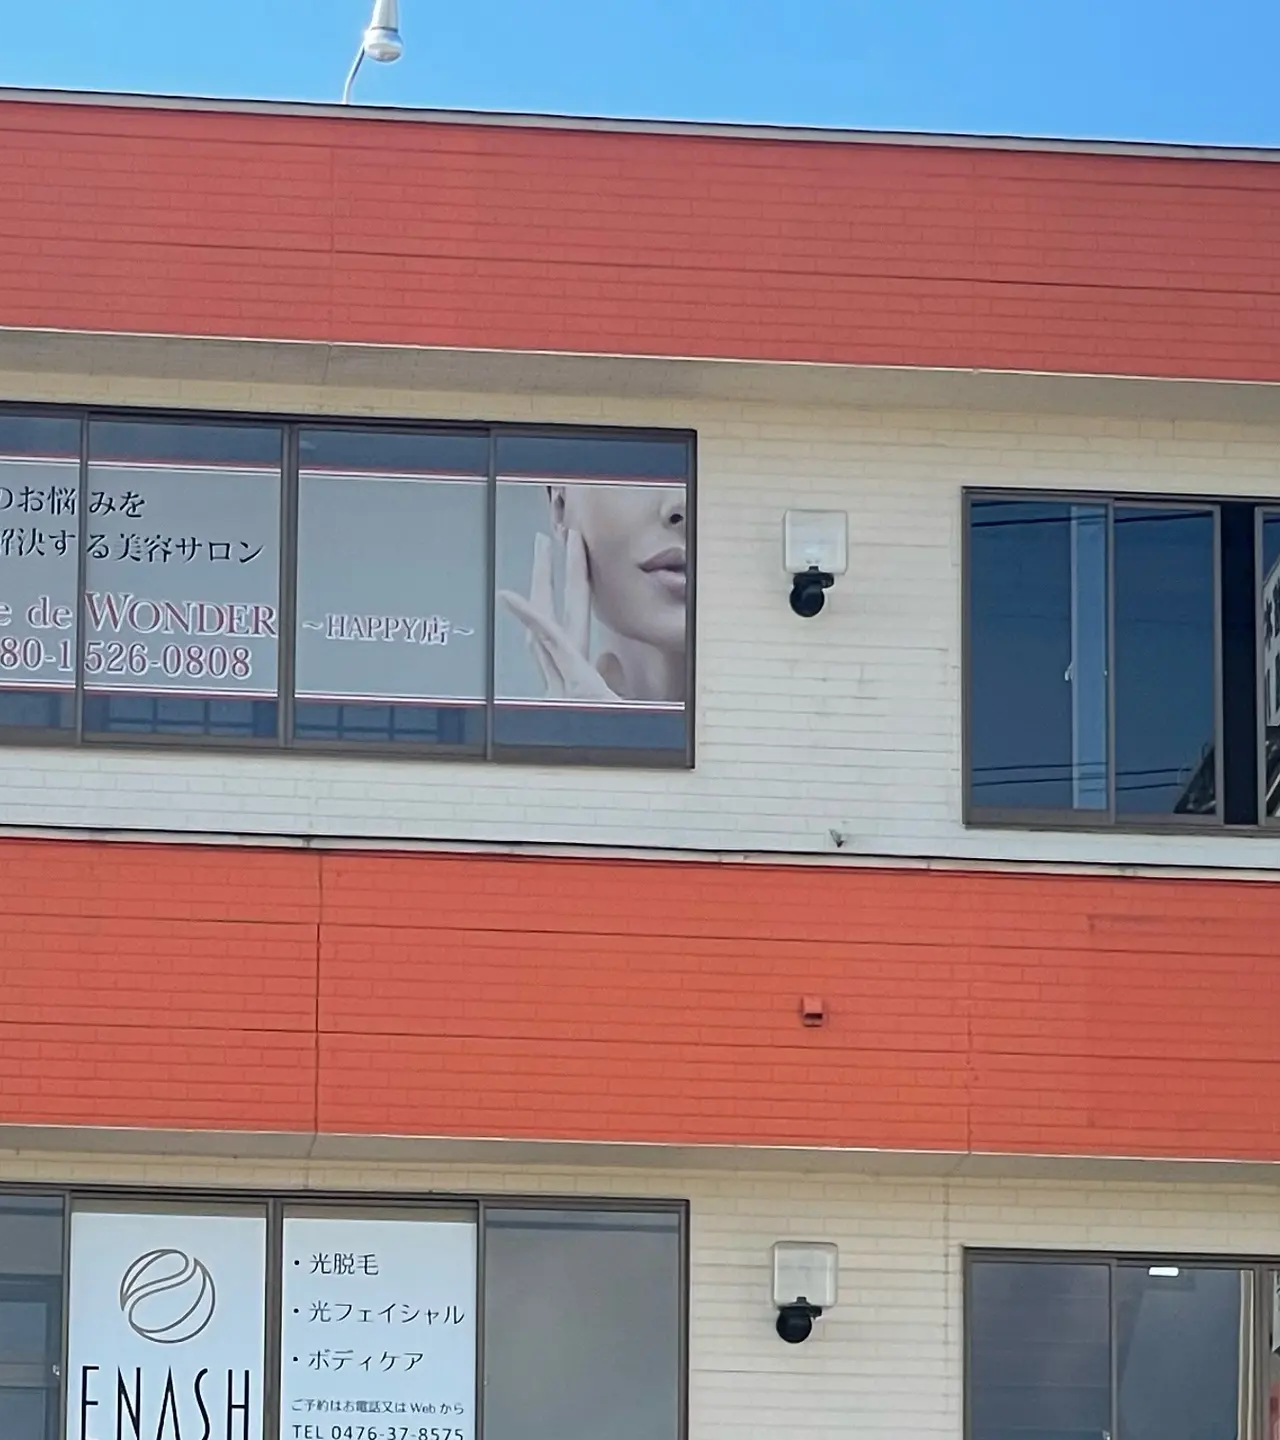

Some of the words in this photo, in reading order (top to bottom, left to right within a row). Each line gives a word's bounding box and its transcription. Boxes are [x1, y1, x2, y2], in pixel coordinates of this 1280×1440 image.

[27, 595, 72, 630] de
[84, 590, 278, 638] WONDER
[292, 1424, 324, 1440] TEL
